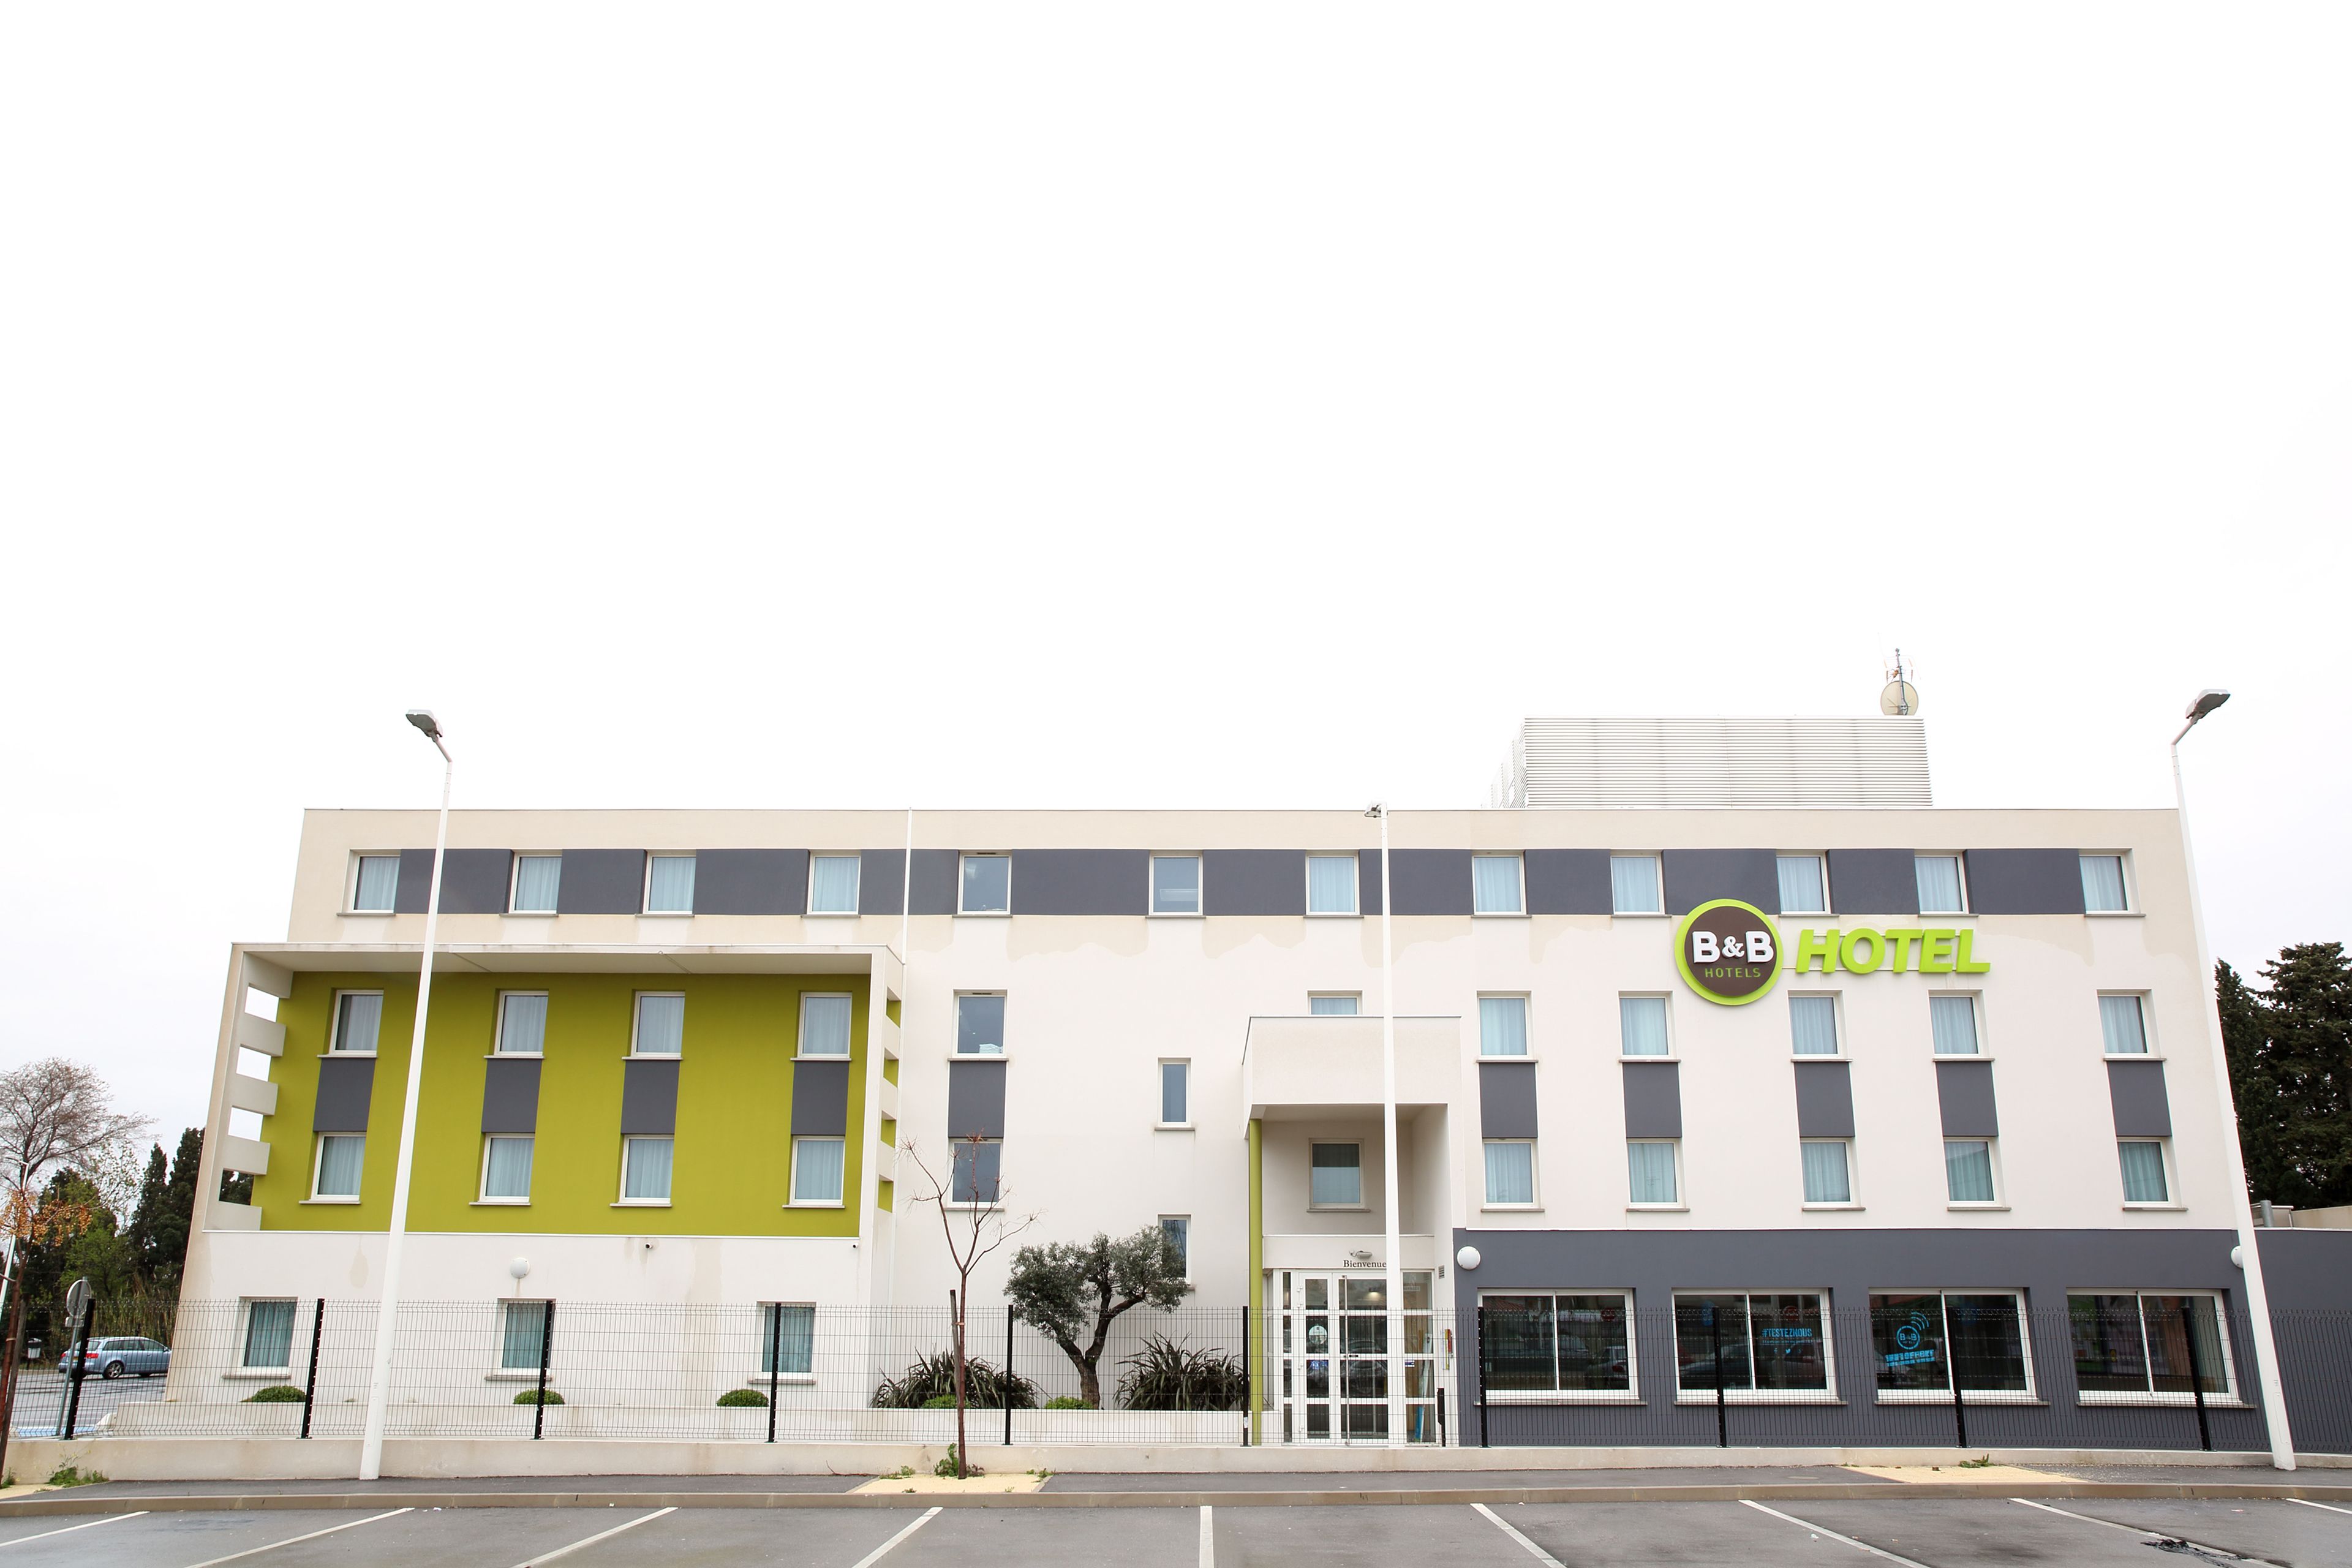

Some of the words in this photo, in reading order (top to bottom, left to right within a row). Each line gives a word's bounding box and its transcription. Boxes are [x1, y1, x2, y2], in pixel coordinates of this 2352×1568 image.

[1692, 931, 1774, 963] B&B
[1795, 928, 1991, 974] HOTEL
[1705, 968, 1761, 978] HOTELS
[1343, 1259, 1387, 1268] Bienvenue
[1762, 1329, 1812, 1337] #TESTEZNOUS
